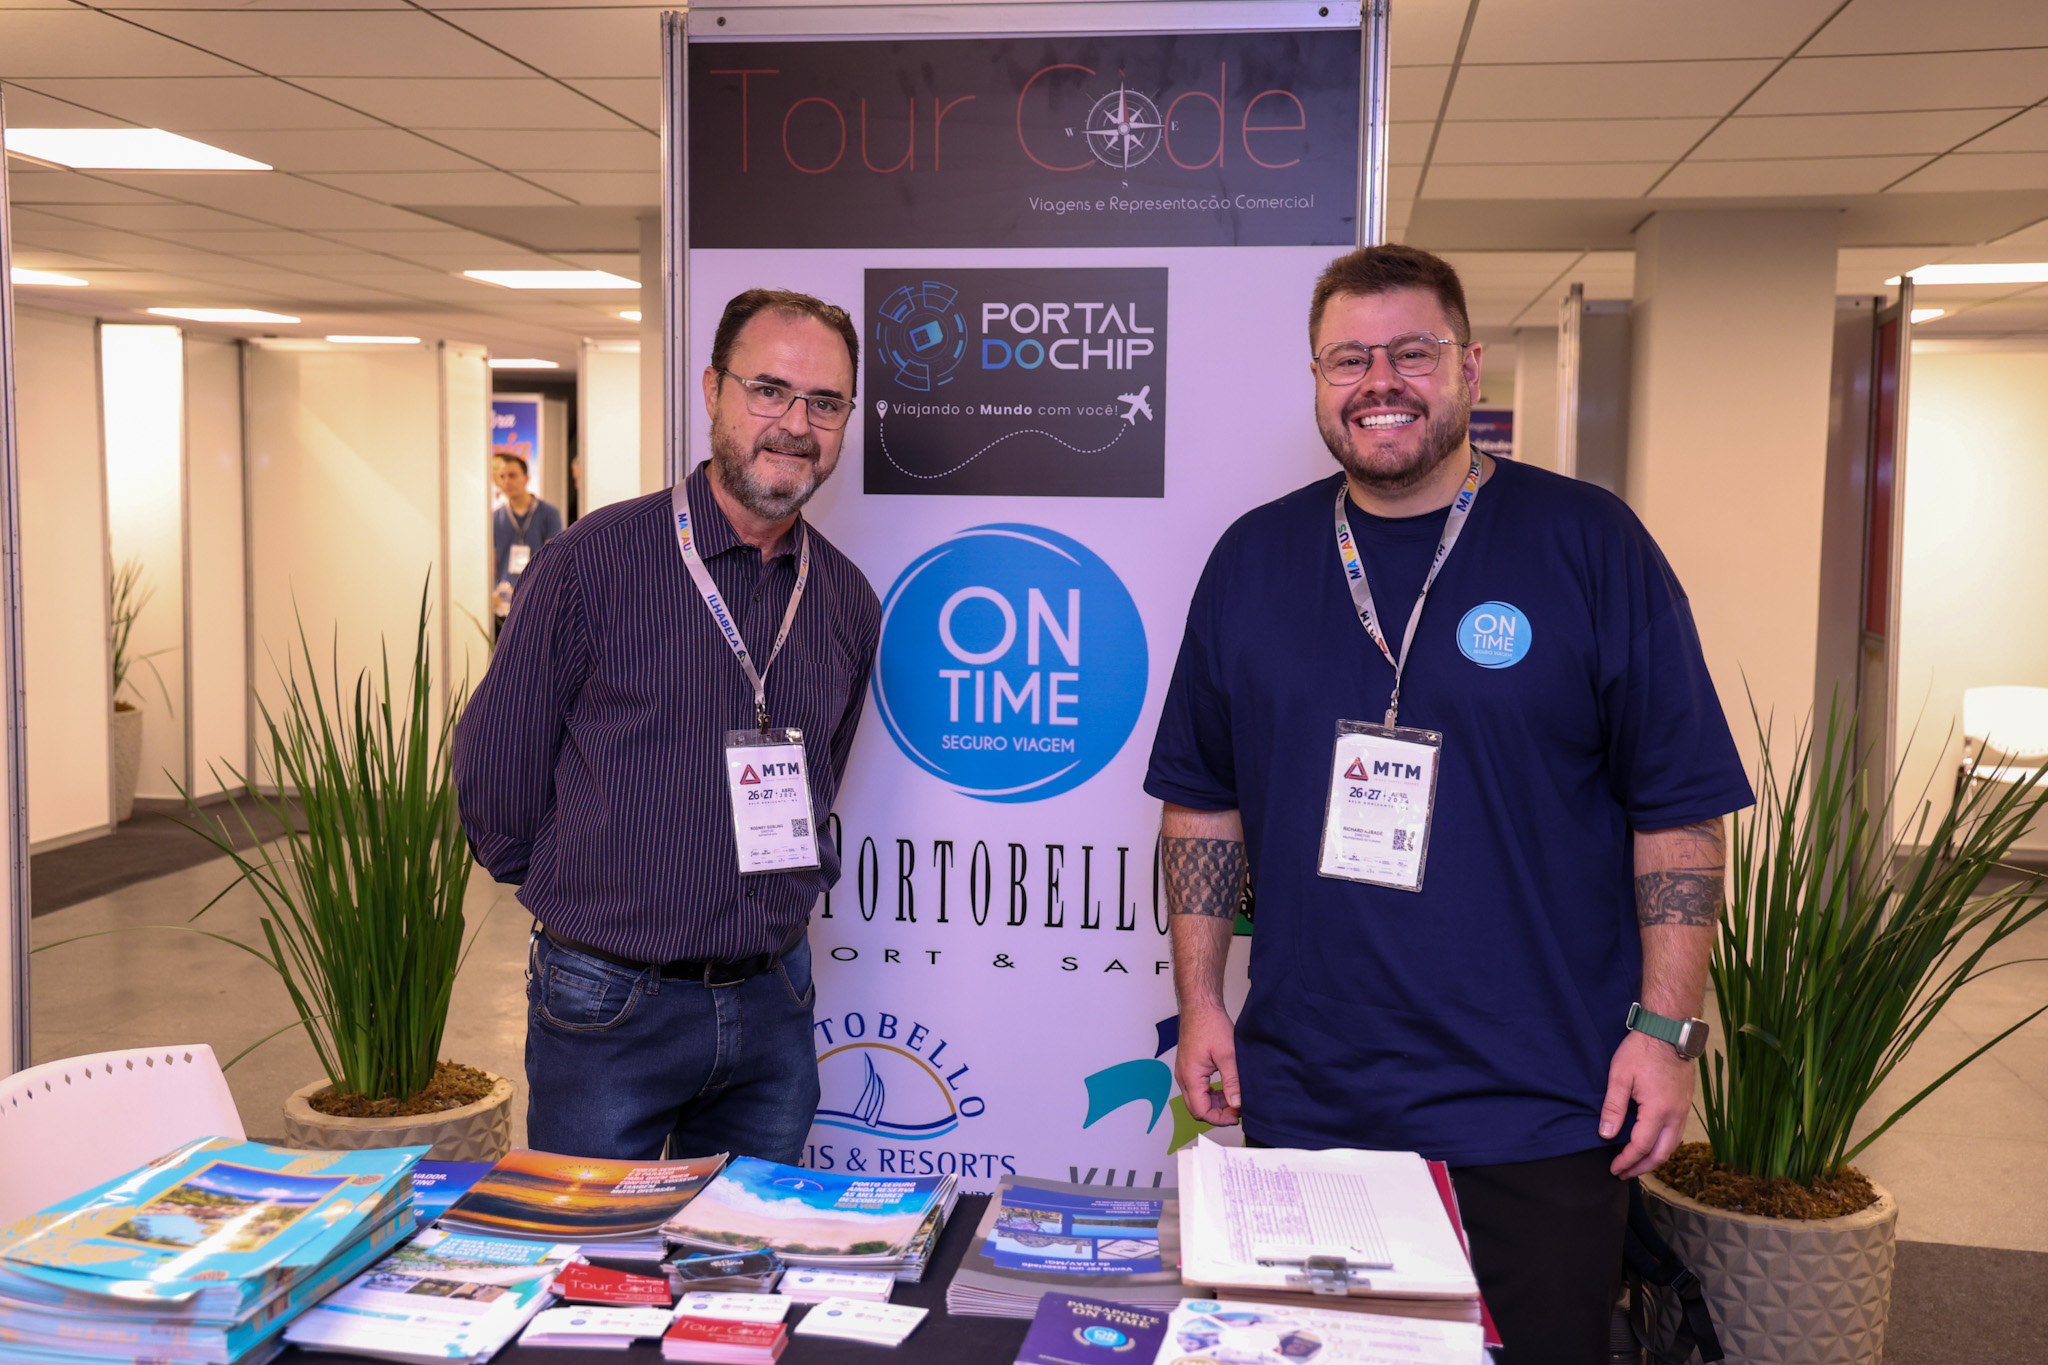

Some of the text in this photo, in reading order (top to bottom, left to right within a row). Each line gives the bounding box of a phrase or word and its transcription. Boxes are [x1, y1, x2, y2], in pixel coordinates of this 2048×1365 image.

[710, 69, 977, 174] Tour
[1065, 127, 1076, 137] W
[1171, 121, 1180, 131] E
[1122, 179, 1129, 189] S
[1029, 194, 1314, 215] Viagens e Representação Comercial
[982, 302, 1155, 334] PORTAL
[892, 403, 1118, 418] Viajando o Mundo com você!
[1456, 461, 1481, 513] MANAUS
[677, 512, 694, 559] MANAUS
[1337, 523, 1363, 581] MANAUS
[796, 550, 809, 593] MANAUS
[707, 593, 740, 649] ILHABELA
[938, 585, 1080, 666] ON
[1474, 613, 1516, 637] ON
[1473, 633, 1514, 652] TIME
[939, 669, 1079, 726] TIME
[941, 734, 1075, 753] SEGURO VIAGEM
[762, 762, 800, 778] MTM
[1373, 760, 1421, 780] MTM
[748, 790, 759, 800] 26
[763, 789, 773, 799] 27
[1349, 787, 1363, 798] 26
[1368, 789, 1381, 800] 27
[831, 947, 1170, 975] ORT & SAF
[814, 1011, 986, 1119] TOBELLO
[846, 1147, 867, 1171] &
[877, 1147, 1016, 1179] RESORTS
[570, 1280, 612, 1290] Tour
[1067, 1300, 1160, 1324] PASSAPORTE
[1071, 1306, 1151, 1328] ON TIME
[680, 1320, 722, 1333] Tour
